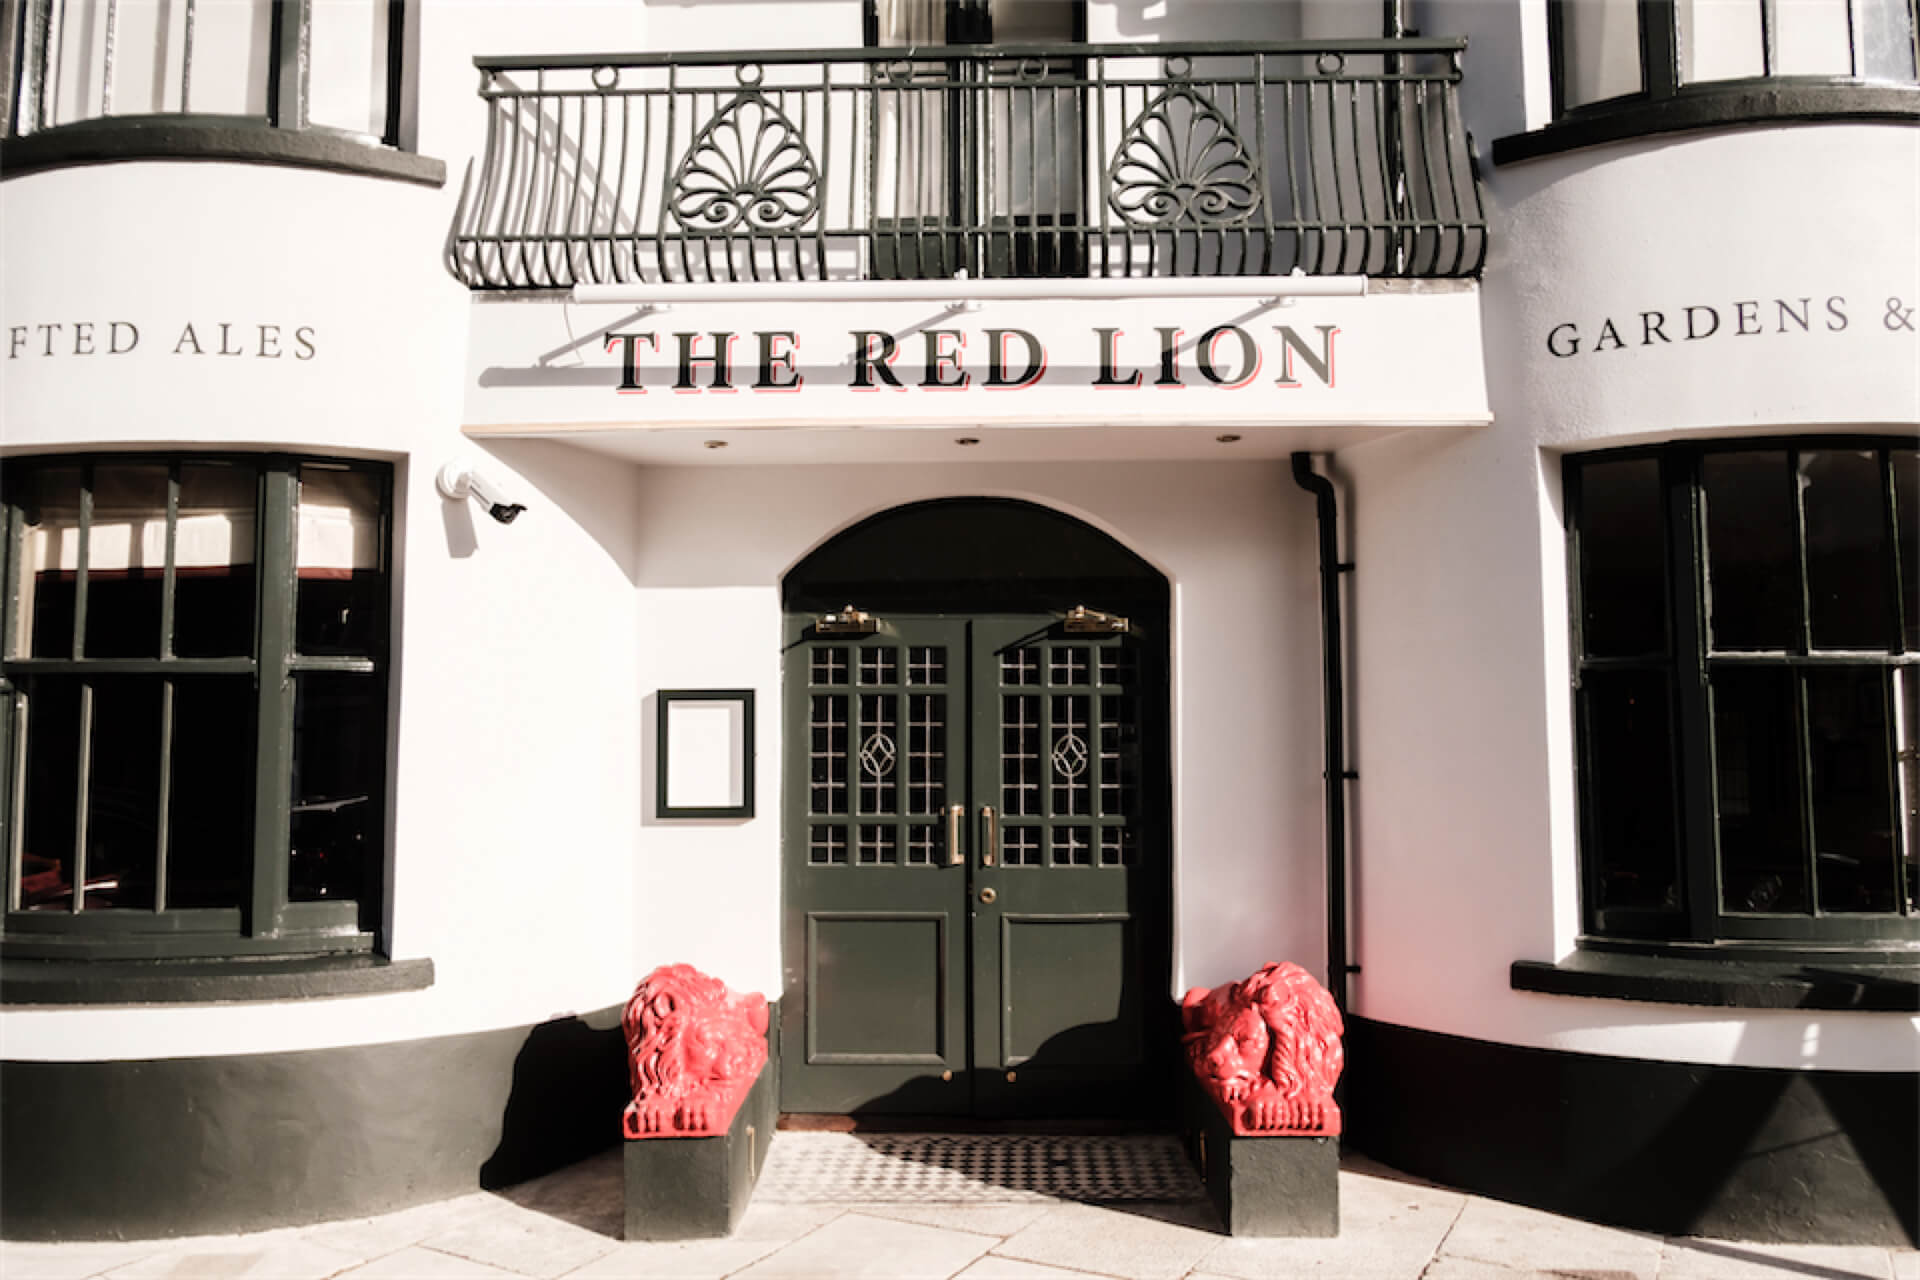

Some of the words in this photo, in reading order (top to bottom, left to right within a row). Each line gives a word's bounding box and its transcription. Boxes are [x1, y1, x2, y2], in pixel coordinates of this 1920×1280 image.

[9, 322, 140, 358] FTED
[173, 322, 317, 360] ALES
[1546, 295, 1849, 358] GARDENS
[1883, 297, 1917, 331] &
[603, 330, 803, 393] THE
[848, 328, 1047, 392] RED
[1091, 325, 1341, 390] LION
